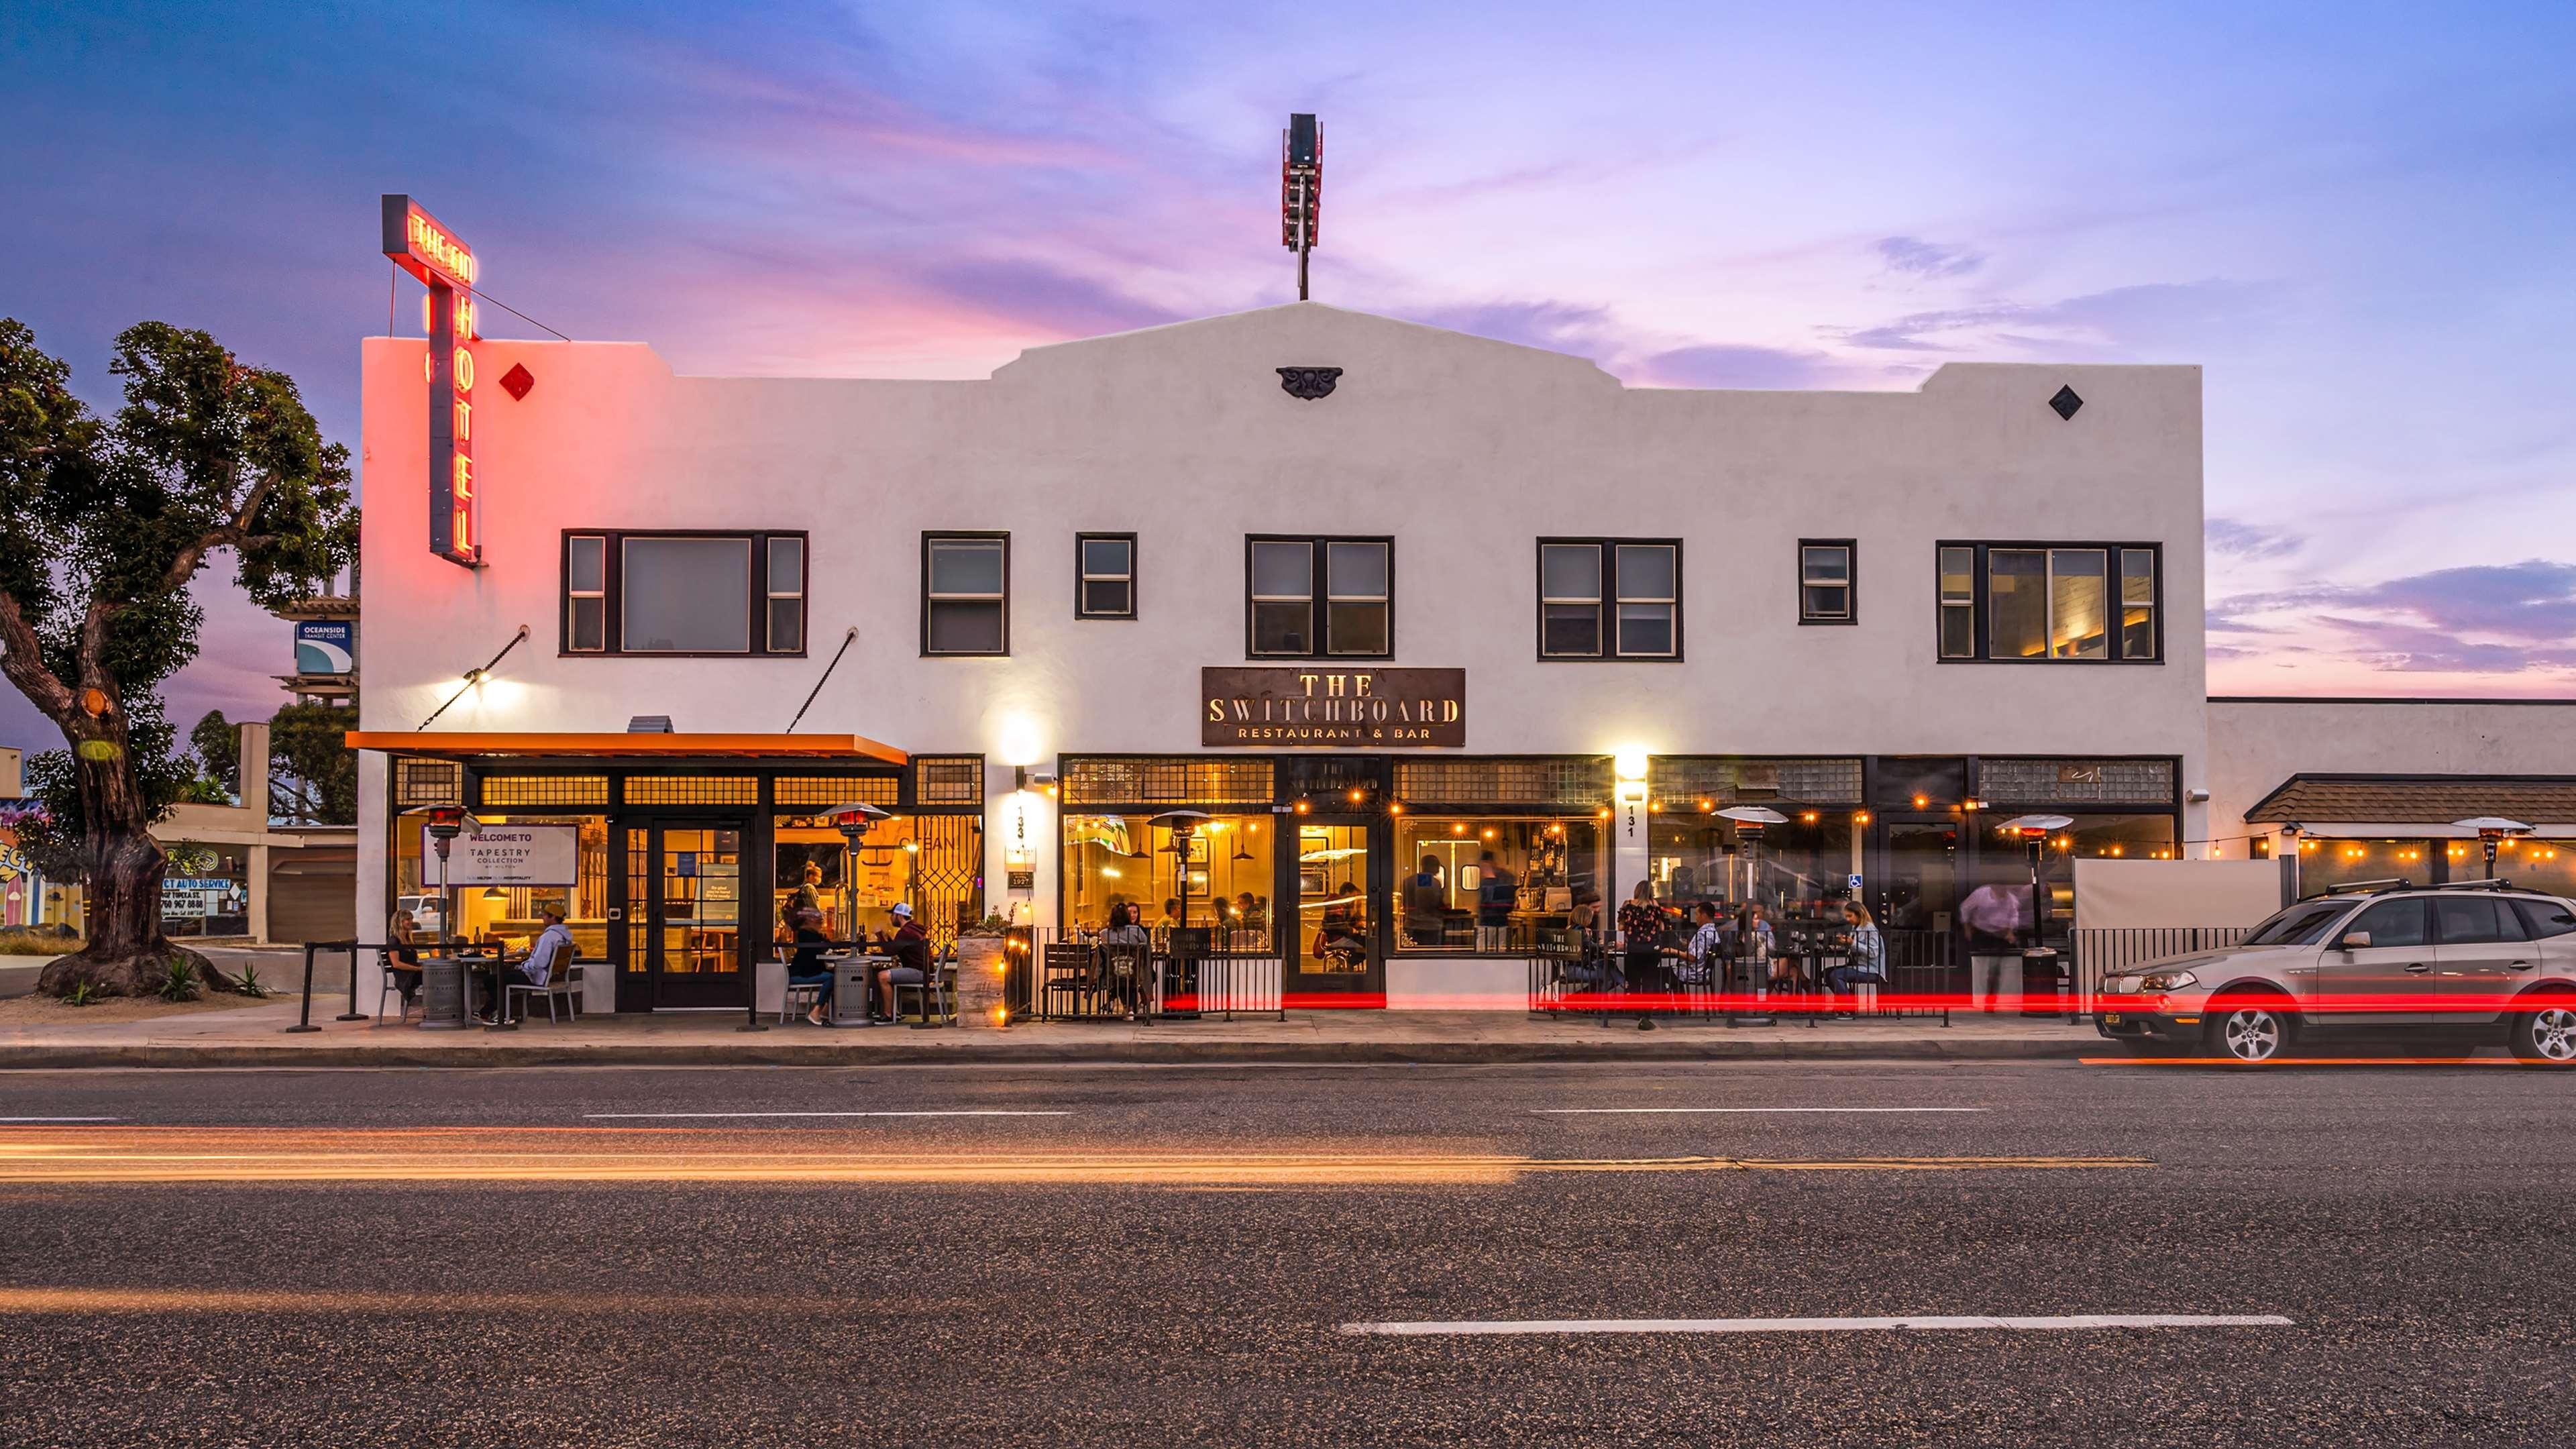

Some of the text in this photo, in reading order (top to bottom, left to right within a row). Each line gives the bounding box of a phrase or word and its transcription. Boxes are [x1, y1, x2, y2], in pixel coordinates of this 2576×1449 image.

[409, 213, 445, 264] THE
[453, 291, 473, 553] HOTEL
[1299, 674, 1371, 697] THE
[1210, 699, 1458, 722] SWITCHBOARD
[1238, 729, 1430, 739] RESTAURANT & BAR
[470, 834, 532, 842] WELCOME TO
[176, 879, 197, 888] AUTO
[199, 879, 229, 888] SERVICE
[174, 900, 185, 909] 967
